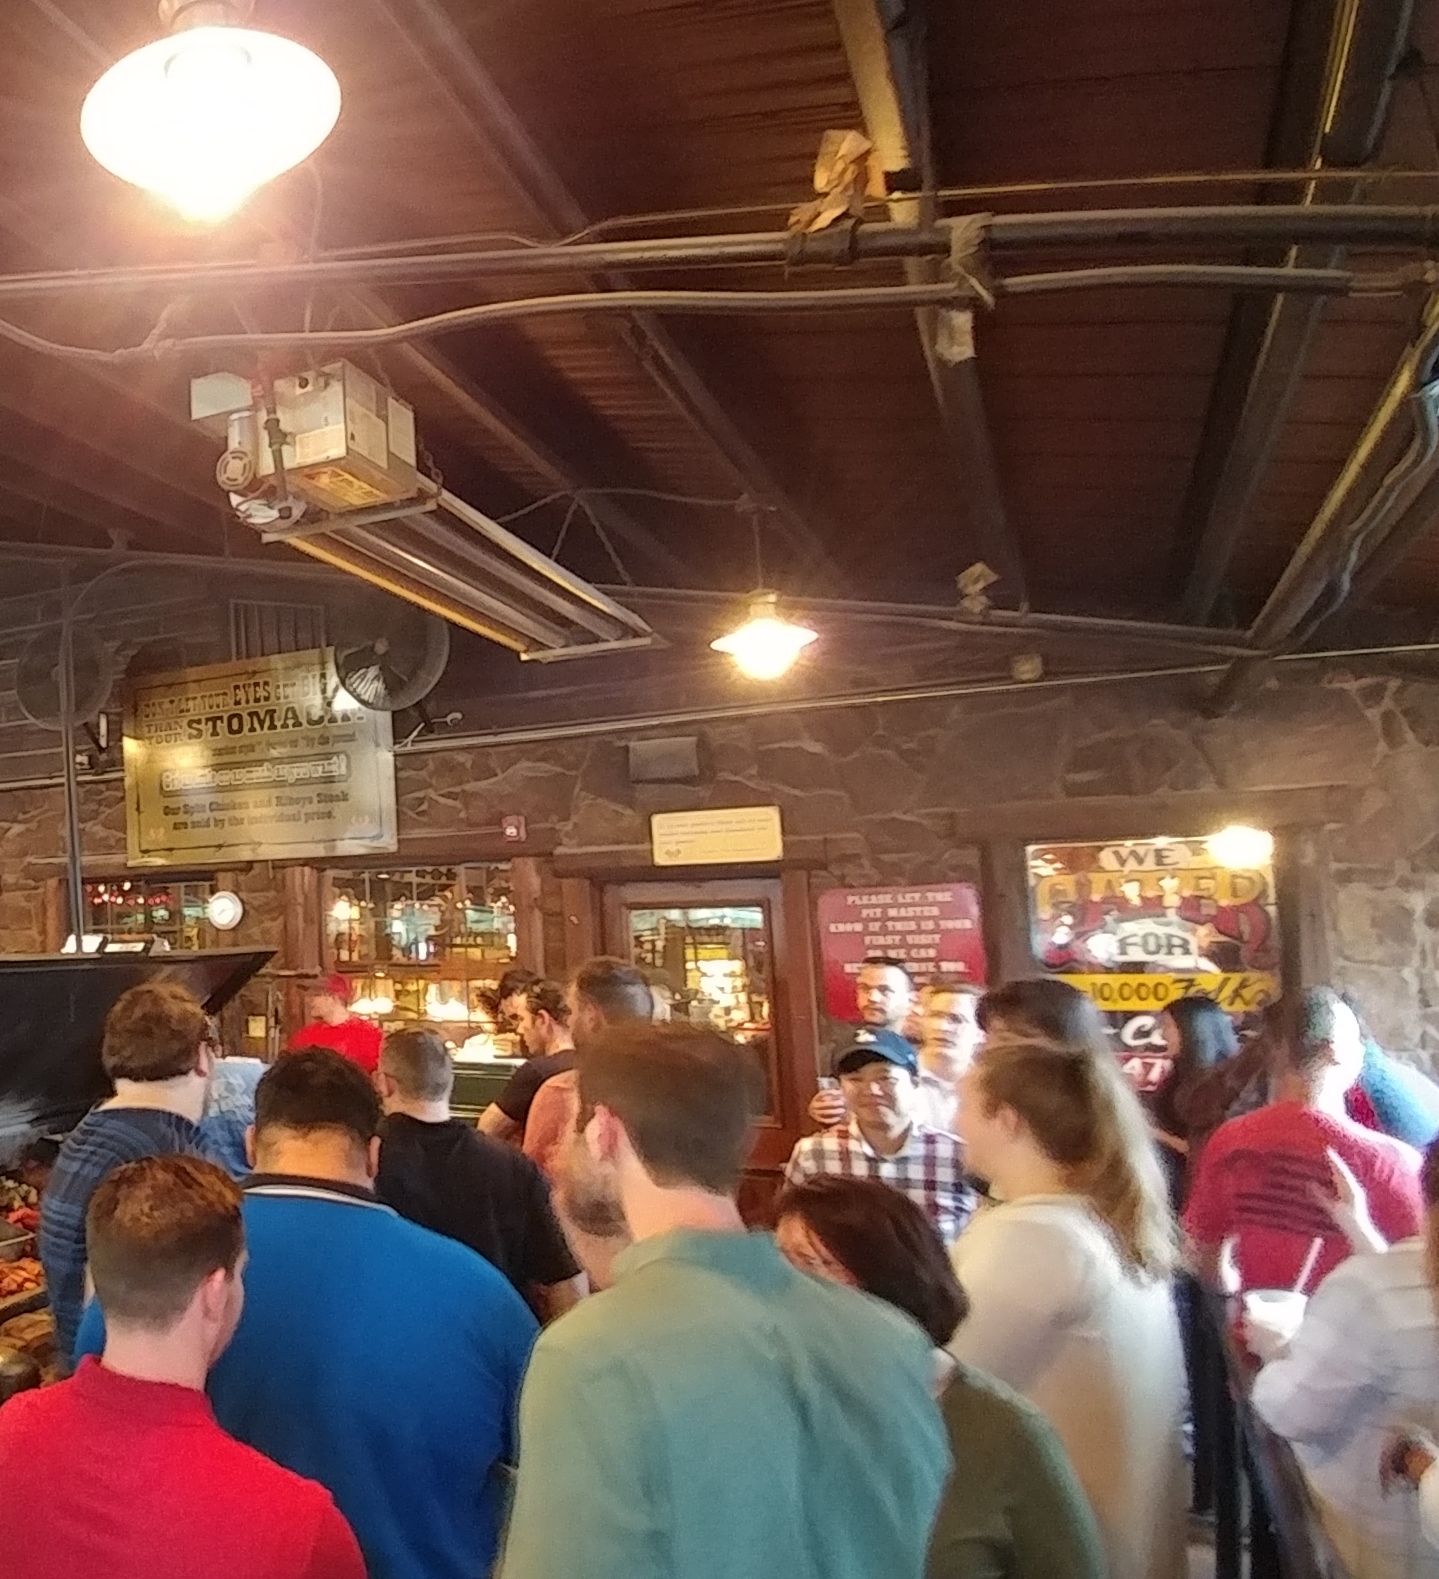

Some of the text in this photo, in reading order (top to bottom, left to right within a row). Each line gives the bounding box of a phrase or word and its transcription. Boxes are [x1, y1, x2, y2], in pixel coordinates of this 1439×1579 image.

[233, 680, 271, 706] EYES
[145, 719, 184, 734] THAN
[145, 732, 183, 745] YOUR
[316, 791, 350, 804] Steak
[1112, 847, 1182, 868] WE
[846, 891, 954, 906] PLEASE LET THE
[861, 906, 940, 919] PIT MASTER
[828, 918, 974, 933] KNOW IF THIS IS YOUR
[863, 934, 942, 946] FIRST VISIT
[1117, 932, 1192, 957] FOR
[1090, 981, 1169, 1004] 10,000
